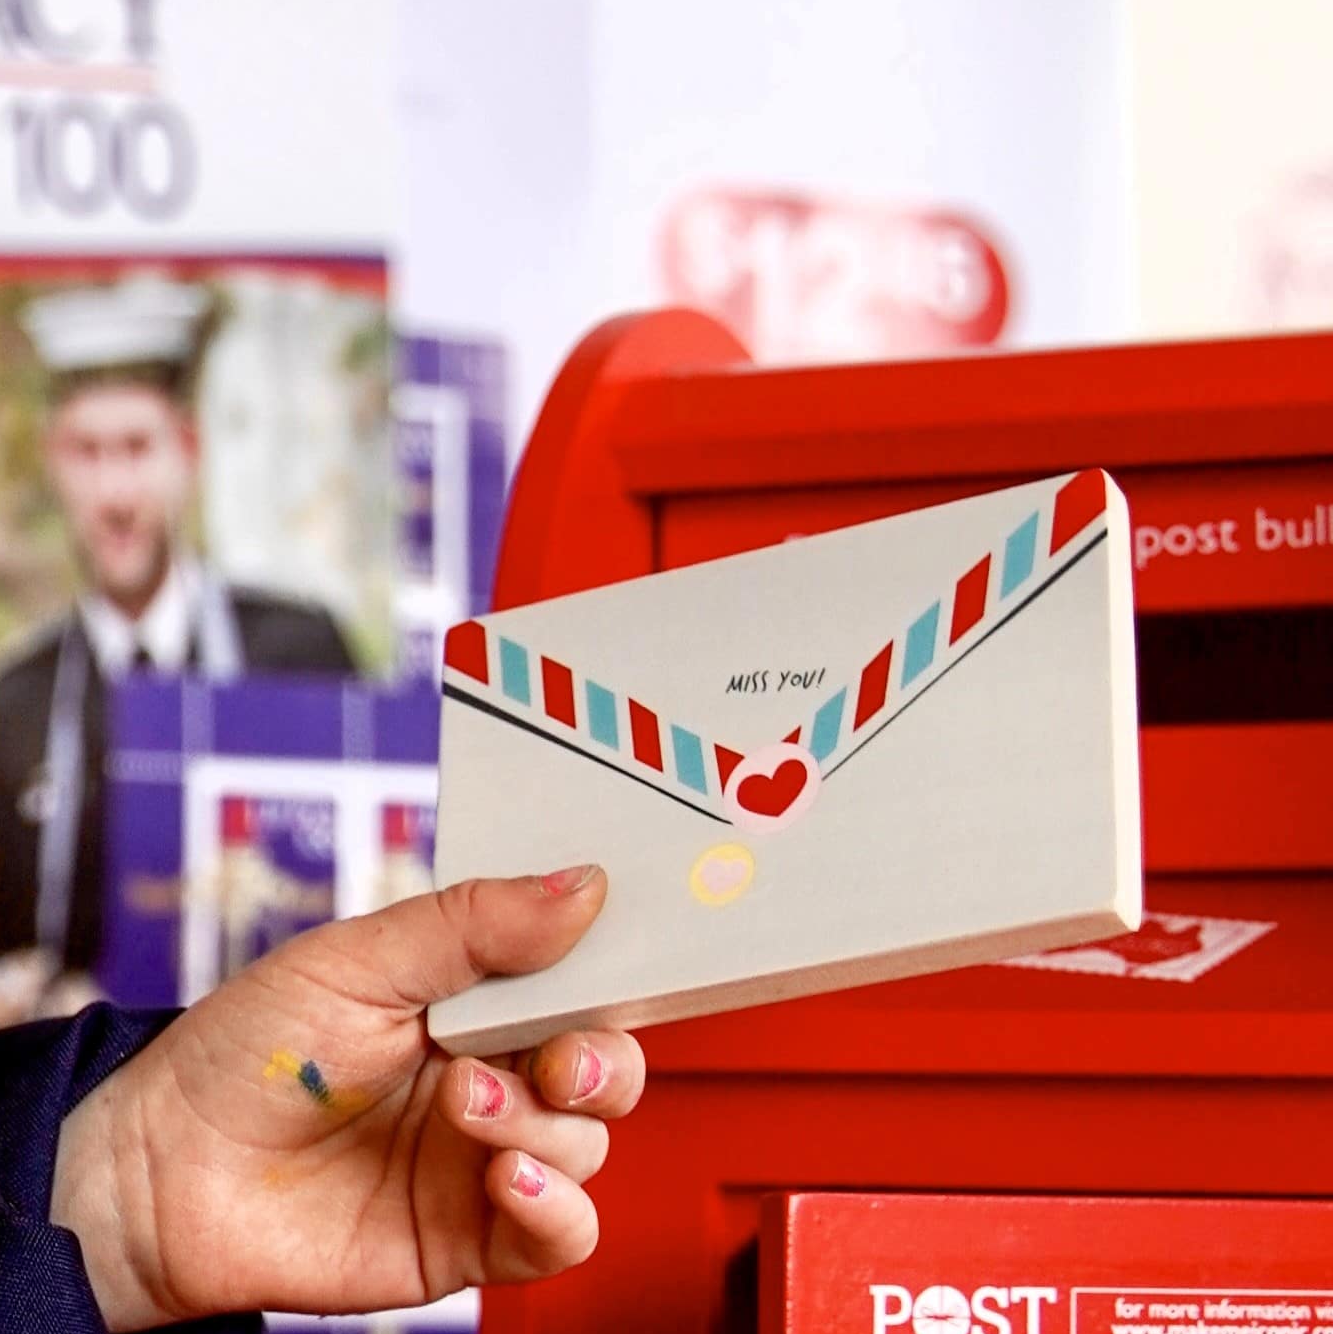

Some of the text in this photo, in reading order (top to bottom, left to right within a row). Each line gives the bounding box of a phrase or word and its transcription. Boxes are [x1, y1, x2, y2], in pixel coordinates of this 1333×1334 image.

[4, 97, 199, 222] 100
[1134, 519, 1241, 571] post
[725, 667, 826, 694] MISS YOU!
[1114, 1297, 1144, 1319] for
[1148, 1302, 1200, 1320] more
[1203, 1298, 1312, 1321] information
